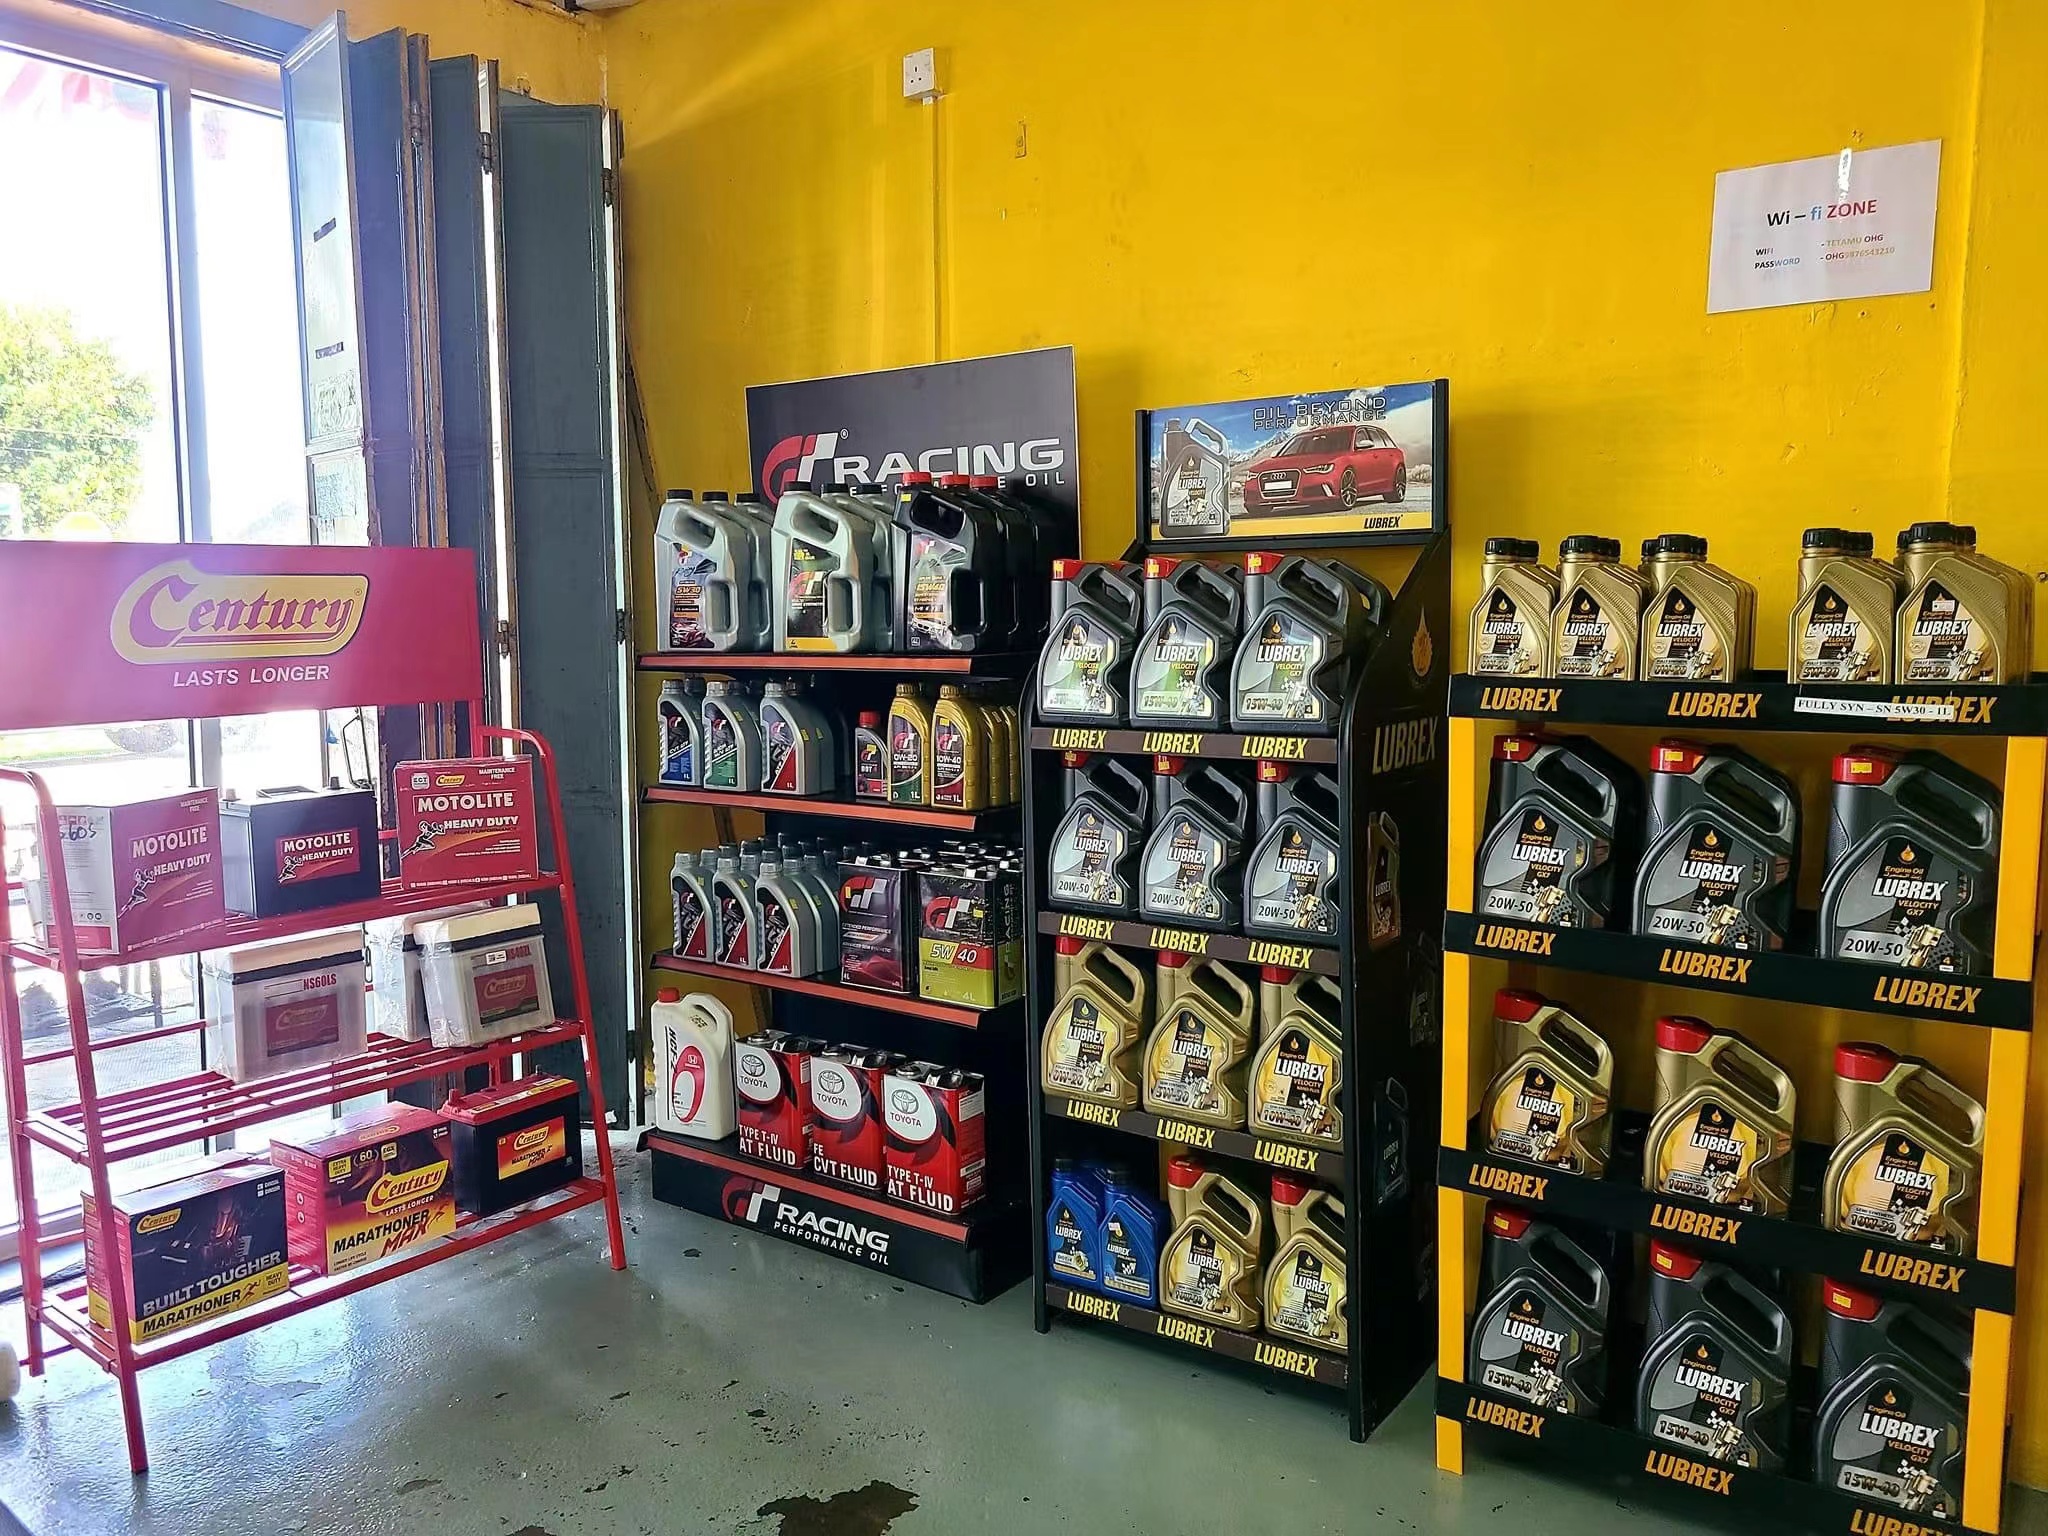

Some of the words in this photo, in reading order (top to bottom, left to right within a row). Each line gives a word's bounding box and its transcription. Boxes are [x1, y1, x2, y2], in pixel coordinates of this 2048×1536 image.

[1767, 210, 1791, 227] Wi
[1810, 206, 1822, 220] fi
[1827, 200, 1877, 219] ZONE
[1864, 234, 1884, 243] OHG
[1755, 248, 1774, 256] WIFI
[1755, 257, 1800, 269] PASSWORD
[1253, 406, 1288, 420] OIL
[1296, 396, 1386, 416] BEYOND
[1253, 410, 1386, 431] PERFORMANCE
[833, 437, 1065, 485] RACING
[1025, 473, 1065, 487] OIL
[1364, 516, 1401, 529] LUBREX
[128, 573, 355, 648] Century
[1482, 621, 1524, 634] LUBREX
[1564, 622, 1609, 636] LUBREX
[1658, 622, 1706, 636] LUBREX
[1914, 620, 1970, 636] LUBREX
[1155, 646, 1202, 662] LUBREX
[1257, 645, 1308, 662] LUBREX
[173, 668, 239, 688] LASTS
[250, 665, 330, 684] LONGER
[1480, 687, 1563, 712] LUBREX
[1667, 691, 1762, 719] LUBREX
[1798, 699, 1835, 710] FULLY
[1840, 702, 1864, 712] SYN
[1875, 704, 1892, 713] SN
[1894, 705, 1926, 715] 5W30
[1052, 729, 1106, 749] LUBREX
[1143, 732, 1203, 753] LUBREX
[1242, 736, 1308, 759] LUBREX
[1372, 716, 1438, 775] LUBREX
[418, 793, 513, 812] MOTOLITE
[444, 818, 484, 829] HEAVY
[487, 816, 519, 826] DUTY
[133, 826, 208, 858] MOTOLITE
[284, 833, 350, 853] MOTOLITE
[1074, 837, 1111, 852] LUBREX
[154, 859, 185, 876] HEAVY
[188, 853, 212, 868] DUTY
[302, 851, 330, 862] HEAVY
[332, 847, 354, 857] DUTY
[1168, 849, 1209, 864] LUBREX
[1512, 844, 1569, 865] LUBREX
[1276, 857, 1321, 875] LUBREX
[1531, 864, 1562, 872] VELOCITY
[1680, 860, 1743, 884] LUBREX
[1885, 866, 1910, 874] Engine
[1058, 880, 1089, 894] 20W-50
[1701, 881, 1737, 891] VELOCITY
[1873, 878, 1946, 901] LUBREX
[1152, 892, 1185, 906] 20W-50
[1488, 896, 1533, 913] 20W-50
[1898, 899, 1939, 910] VELOCITY
[1258, 906, 1295, 919] 20W-50
[1906, 908, 1924, 917] GX7
[1060, 915, 1115, 940] LUBREX
[1653, 916, 1704, 933] 20W-50
[1150, 927, 1210, 954] LUBREX
[1475, 924, 1557, 955] LUBREX
[1846, 939, 1903, 956] 20W-50
[931, 944, 954, 959] 5W
[957, 949, 977, 963] 40
[1248, 941, 1313, 969] LUBREX
[1659, 949, 1752, 984] LUBREX
[303, 974, 337, 990] NS60LS
[1874, 976, 1983, 1014] LUBREX
[1067, 1026, 1106, 1044] LUBREX
[1172, 1040, 1214, 1060] LUBREX
[1275, 1058, 1327, 1081] LUBREX
[740, 1075, 769, 1089] TOYOTA
[1293, 1079, 1322, 1088] VELOCITY
[816, 1093, 848, 1108] TOYOTA
[1517, 1095, 1565, 1117] LUBREX
[889, 1112, 921, 1128] TOYOTA
[1067, 1100, 1121, 1127] LUBREX
[739, 1124, 763, 1139] TYPE
[765, 1131, 778, 1144] T-IV
[1157, 1119, 1216, 1149] LUBREX
[1690, 1133, 1746, 1155] LUBREX
[360, 1150, 372, 1161] 60
[740, 1138, 754, 1153] AT
[758, 1143, 796, 1166] FLUID
[814, 1143, 823, 1156] FE
[1254, 1140, 1318, 1171] LUBREX
[1709, 1152, 1740, 1162] VELOCITY
[814, 1156, 837, 1177] CVT
[840, 1164, 877, 1187] FLUID
[887, 1165, 911, 1183] TYPE
[913, 1173, 934, 1189] T-IV
[1876, 1165, 1937, 1190] LUBREX
[372, 1168, 444, 1208] Century
[1469, 1164, 1549, 1201] LUBREX
[1896, 1185, 1931, 1196] VELOCITY
[887, 1180, 903, 1197] AT
[910, 1186, 953, 1212] FLUID
[334, 1209, 429, 1254] MARATHONER
[777, 1204, 890, 1253] RACING
[1055, 1226, 1082, 1241] LUBREX
[1651, 1204, 1742, 1244] LUBREX
[774, 1220, 862, 1257] PERFORMANCE
[870, 1252, 889, 1266] OIL
[1188, 1253, 1224, 1271] LUBREX
[1860, 1249, 1968, 1293] LUBREX
[143, 1283, 195, 1317] BUILT
[196, 1251, 282, 1291] TOUGHER
[1293, 1275, 1330, 1295] LUBREX
[143, 1288, 241, 1334] MARATHONER
[1067, 1291, 1121, 1322] LUBREX
[1157, 1315, 1216, 1348] LUBREX
[1502, 1319, 1565, 1351] LUBREX
[1254, 1343, 1319, 1378] LUBREX
[1524, 1343, 1559, 1358] VELOCITY
[1541, 1356, 1556, 1365] GX7
[1683, 1358, 1706, 1369] Engine
[1706, 1364, 1717, 1372] Oil
[1487, 1369, 1532, 1394] 15W-40
[1675, 1365, 1747, 1401] LUBREX
[1700, 1392, 1739, 1409] VELOCITY
[1719, 1406, 1735, 1415] GX7
[1868, 1404, 1893, 1416] Engine
[1466, 1397, 1546, 1439] LUBREX
[1659, 1420, 1710, 1445] 15W-40
[1860, 1412, 1940, 1449] LUBREX
[1888, 1440, 1933, 1456] VELOCITY
[1910, 1454, 1928, 1464] GX7
[1645, 1449, 1735, 1495] LUBREX
[1842, 1472, 1900, 1497] 15W-40
